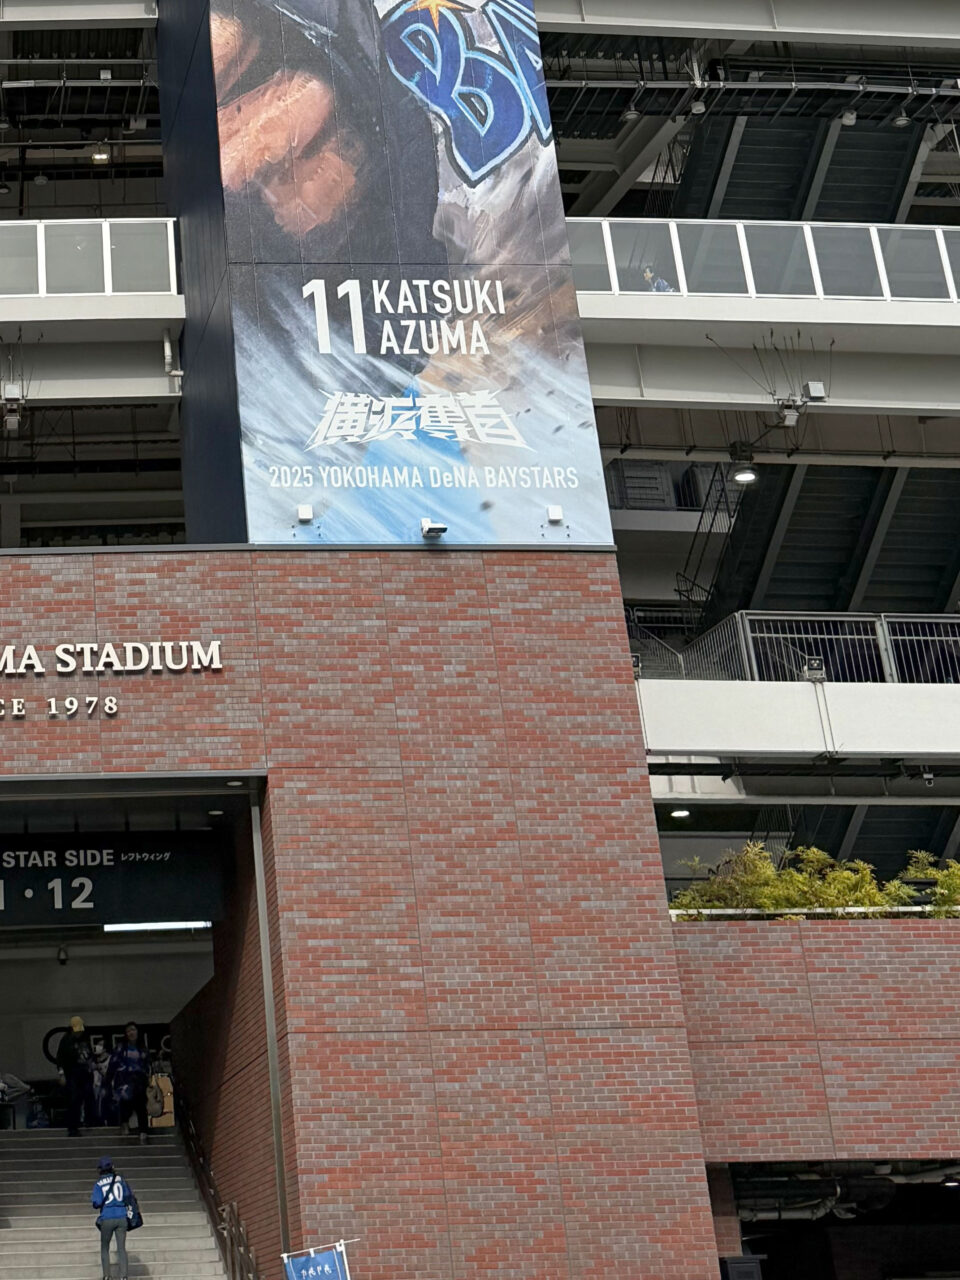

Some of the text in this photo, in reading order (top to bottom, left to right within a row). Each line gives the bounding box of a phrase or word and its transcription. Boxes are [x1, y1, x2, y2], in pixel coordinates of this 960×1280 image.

[372, 279, 506, 315] KATSUKI
[302, 279, 367, 354] 11
[379, 320, 491, 355] AZUMA
[269, 466, 579, 489] 2025 YOKOHAMA DeNA BAYSTARS
[54, 640, 223, 674] STADIUM
[47, 696, 119, 716] 1978
[2, 850, 57, 868] STAR
[64, 849, 115, 867] SIDE
